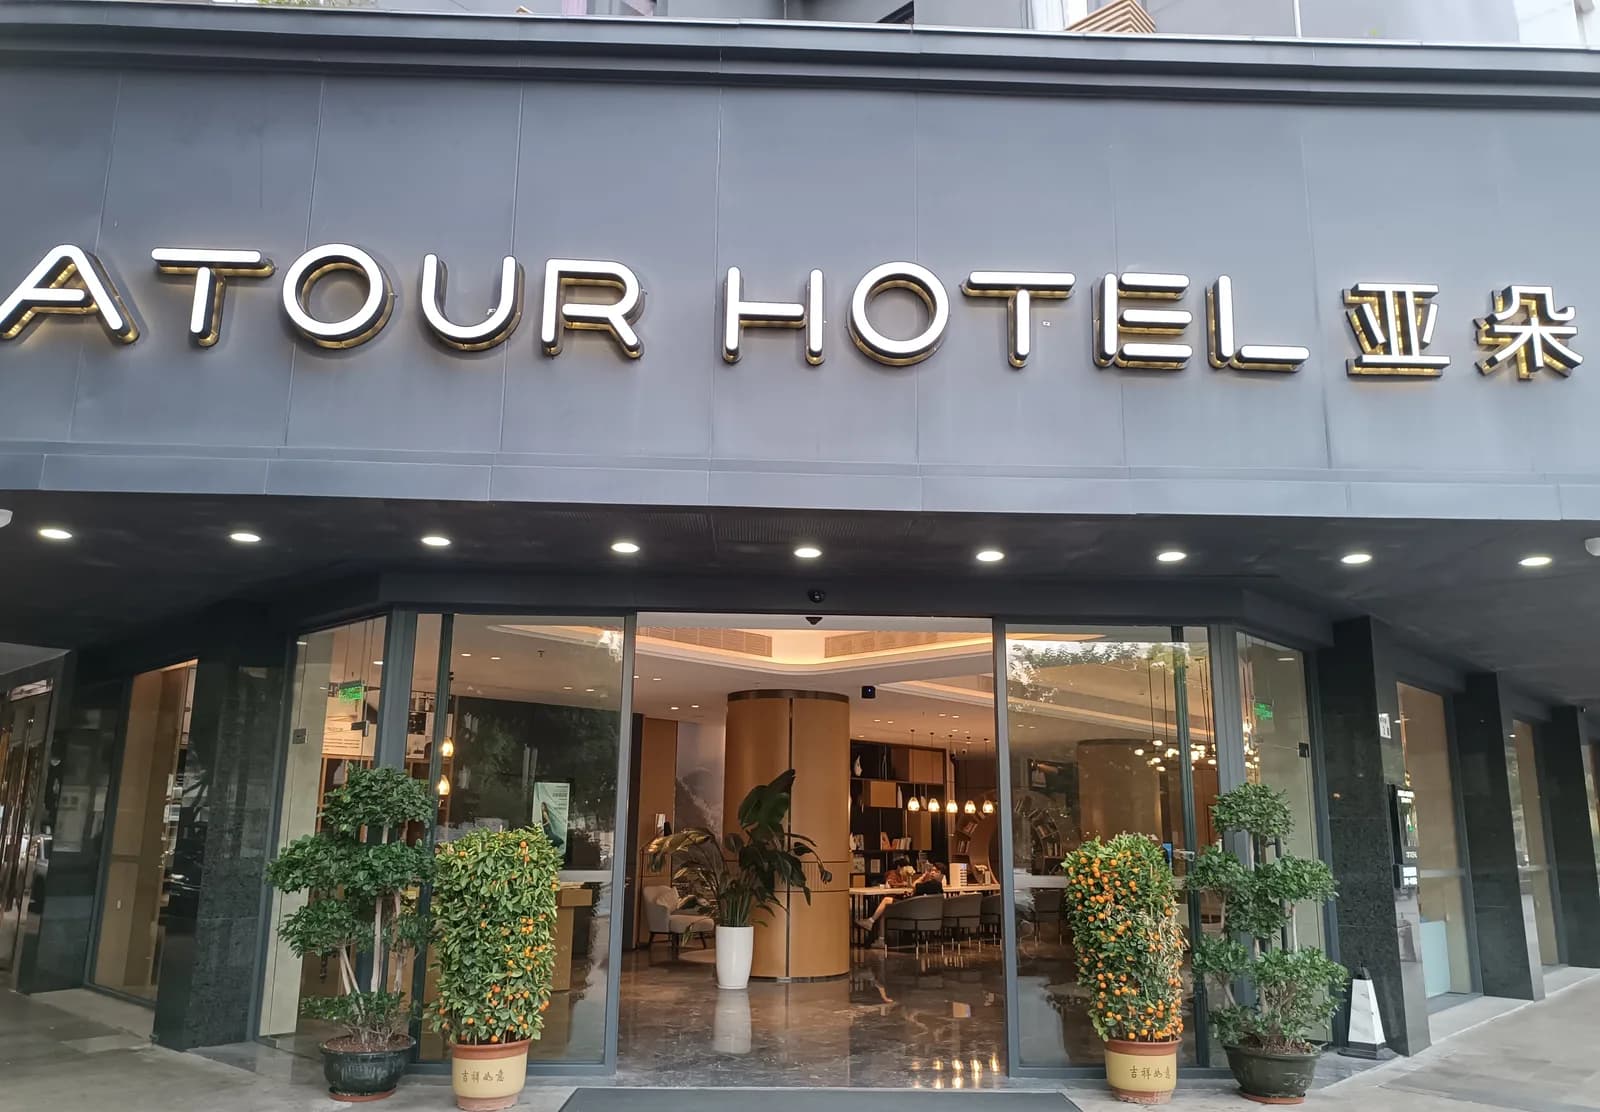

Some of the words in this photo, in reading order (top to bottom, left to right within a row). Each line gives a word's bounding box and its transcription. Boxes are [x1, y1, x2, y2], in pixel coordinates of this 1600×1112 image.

[0, 243, 642, 358] ATOUR
[722, 261, 1311, 372] HOTEL
[1342, 282, 1584, 380] 亚朵
